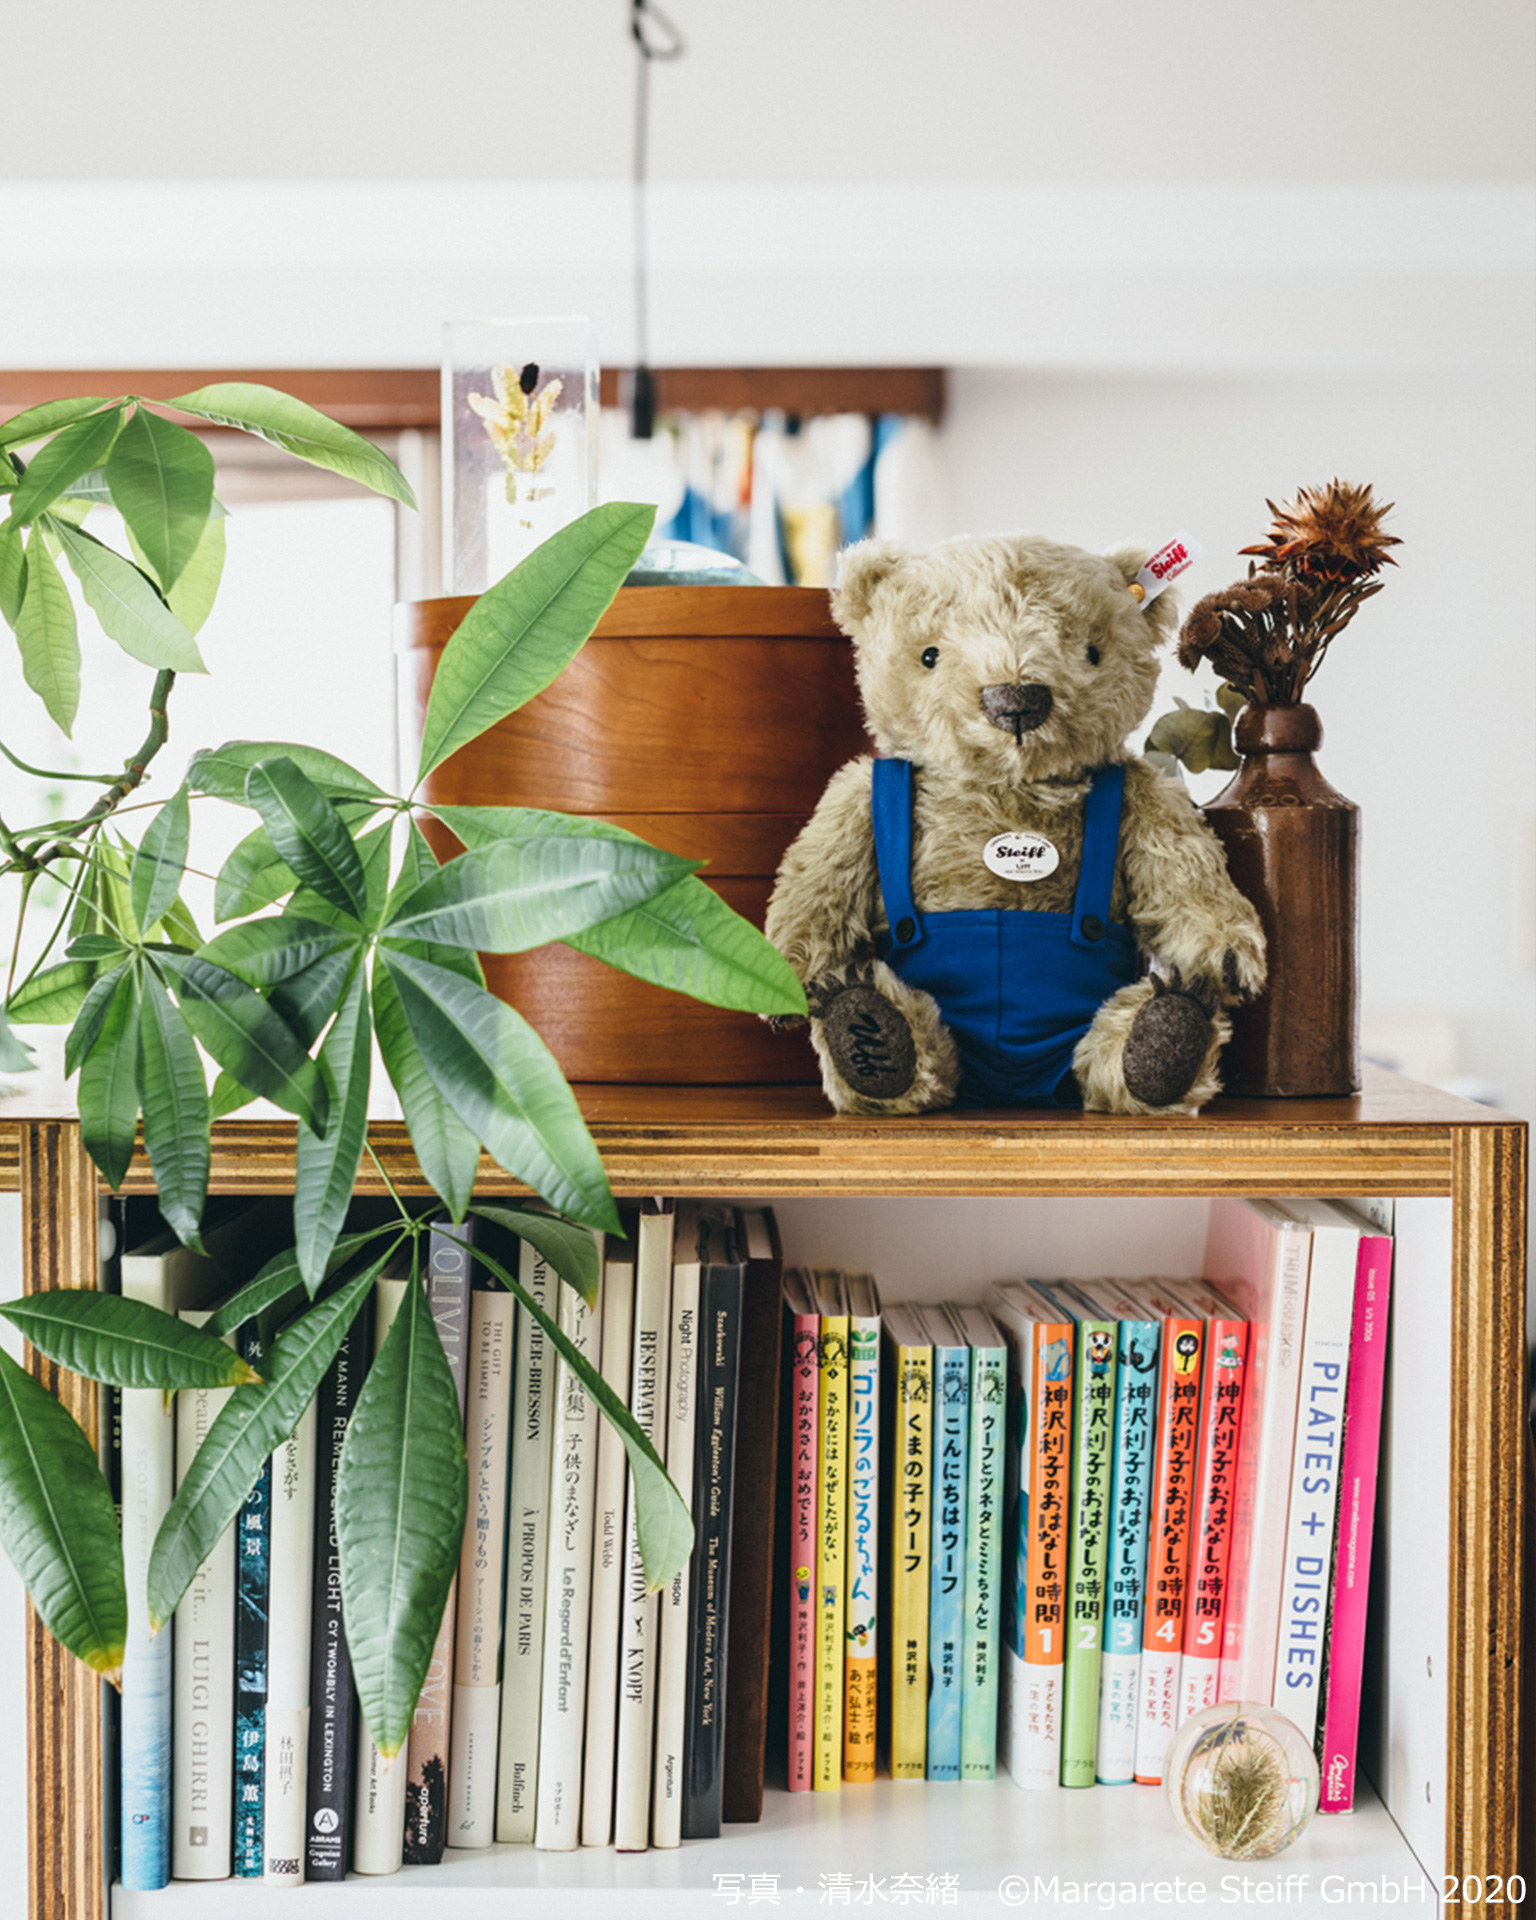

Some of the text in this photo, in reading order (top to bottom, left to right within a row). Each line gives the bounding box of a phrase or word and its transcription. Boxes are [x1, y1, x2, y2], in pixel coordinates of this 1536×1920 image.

[1150, 543, 1189, 580] Steiff
[995, 845, 1047, 859] Steiff
[1363, 1268, 1377, 1343] issue 05 s/s 2006
[478, 1321, 491, 1400] TO BE SIMPLE
[491, 1321, 503, 1376] THE GIFT
[675, 1310, 694, 1423] Night Photography
[714, 1309, 728, 1367] Szarkowski
[335, 1361, 349, 1407] MANN
[637, 1330, 659, 1441] RESERVATIO
[709, 1386, 726, 1517] William Eggleston's Guide
[797, 1390, 813, 1462] おかあさん
[824, 1391, 840, 1461] さかなには
[796, 1467, 812, 1543] おめでとう
[903, 1413, 924, 1574] くまの子ウーフ
[940, 1417, 962, 1595] こんにちはウーフ
[975, 1414, 996, 1631] ウーフとツネタとミミちゃんと
[1035, 1385, 1070, 1625] 神沢利子のおはなしの時間
[1074, 1382, 1112, 1622] 神沢利子のおはなしの時間
[1113, 1382, 1151, 1621] 神沢利子のおはなしの時間
[1156, 1380, 1197, 1619] 神沢利子のおはなしの時間
[1195, 1381, 1241, 1619] 神沢利子のおはなしの時間
[1286, 1361, 1341, 1689] PLATES + DISHES
[602, 1509, 616, 1568] Todd Webb
[1346, 1476, 1362, 1589] www.ameliasmagazine.com
[326, 1555, 341, 1612] LIGHT
[517, 1506, 541, 1657] À PROPOS DE PARIS
[556, 1567, 577, 1713] Le Regard d'Enfant
[701, 1536, 719, 1726] The Museum of Modern Art, New York
[906, 1639, 918, 1686] 神沢利子
[1037, 1628, 1053, 1654] 1
[1076, 1624, 1097, 1650] 2
[1116, 1622, 1134, 1647] 3
[1155, 1619, 1176, 1643] 4
[1196, 1620, 1216, 1646] 5
[624, 1648, 645, 1704] KNOPF
[942, 1641, 955, 1688] 神沢利子
[975, 1640, 988, 1687] 神沢利子
[1202, 1672, 1213, 1707] 子ども
[190, 1640, 211, 1812] LUIGI GHIRRI
[322, 1619, 339, 1793] CY TWOMBLY IN LEXINGTON
[848, 1668, 862, 1745] あべ弘士・絵
[1043, 1679, 1055, 1743] 子どもたちへ
[1125, 1668, 1137, 1730] 子どもたちへ
[1161, 1666, 1174, 1729] 子どもたちへ
[242, 1729, 260, 1802] 伊島薫
[511, 1762, 526, 1814] Bulfinch
[664, 1754, 676, 1798] Argentum
[1327, 1763, 1336, 1801] magazine
[367, 1791, 377, 1814] Books
[417, 1786, 431, 1845] aperture
[309, 1836, 341, 1844] ABRAMS
[311, 1857, 338, 1869] Gallery
